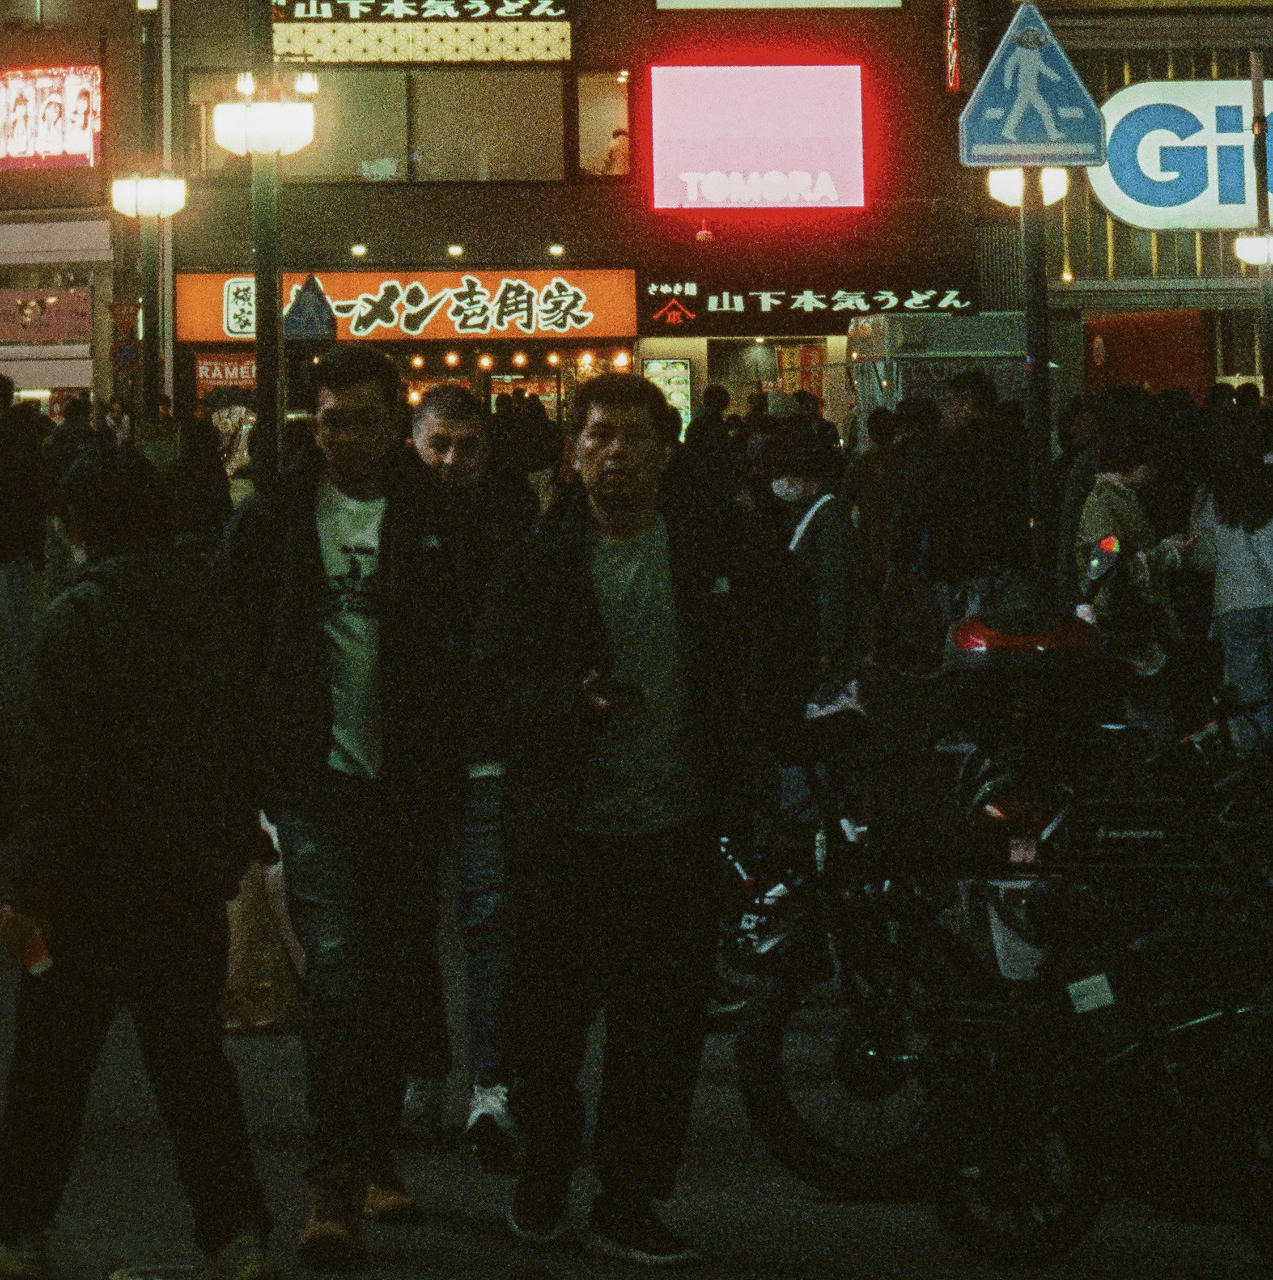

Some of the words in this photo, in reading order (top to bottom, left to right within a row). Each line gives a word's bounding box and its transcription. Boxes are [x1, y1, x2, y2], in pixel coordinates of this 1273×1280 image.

[284, 276, 593, 335] ーメン壱角家
[707, 290, 971, 313] 山下本気うどん
